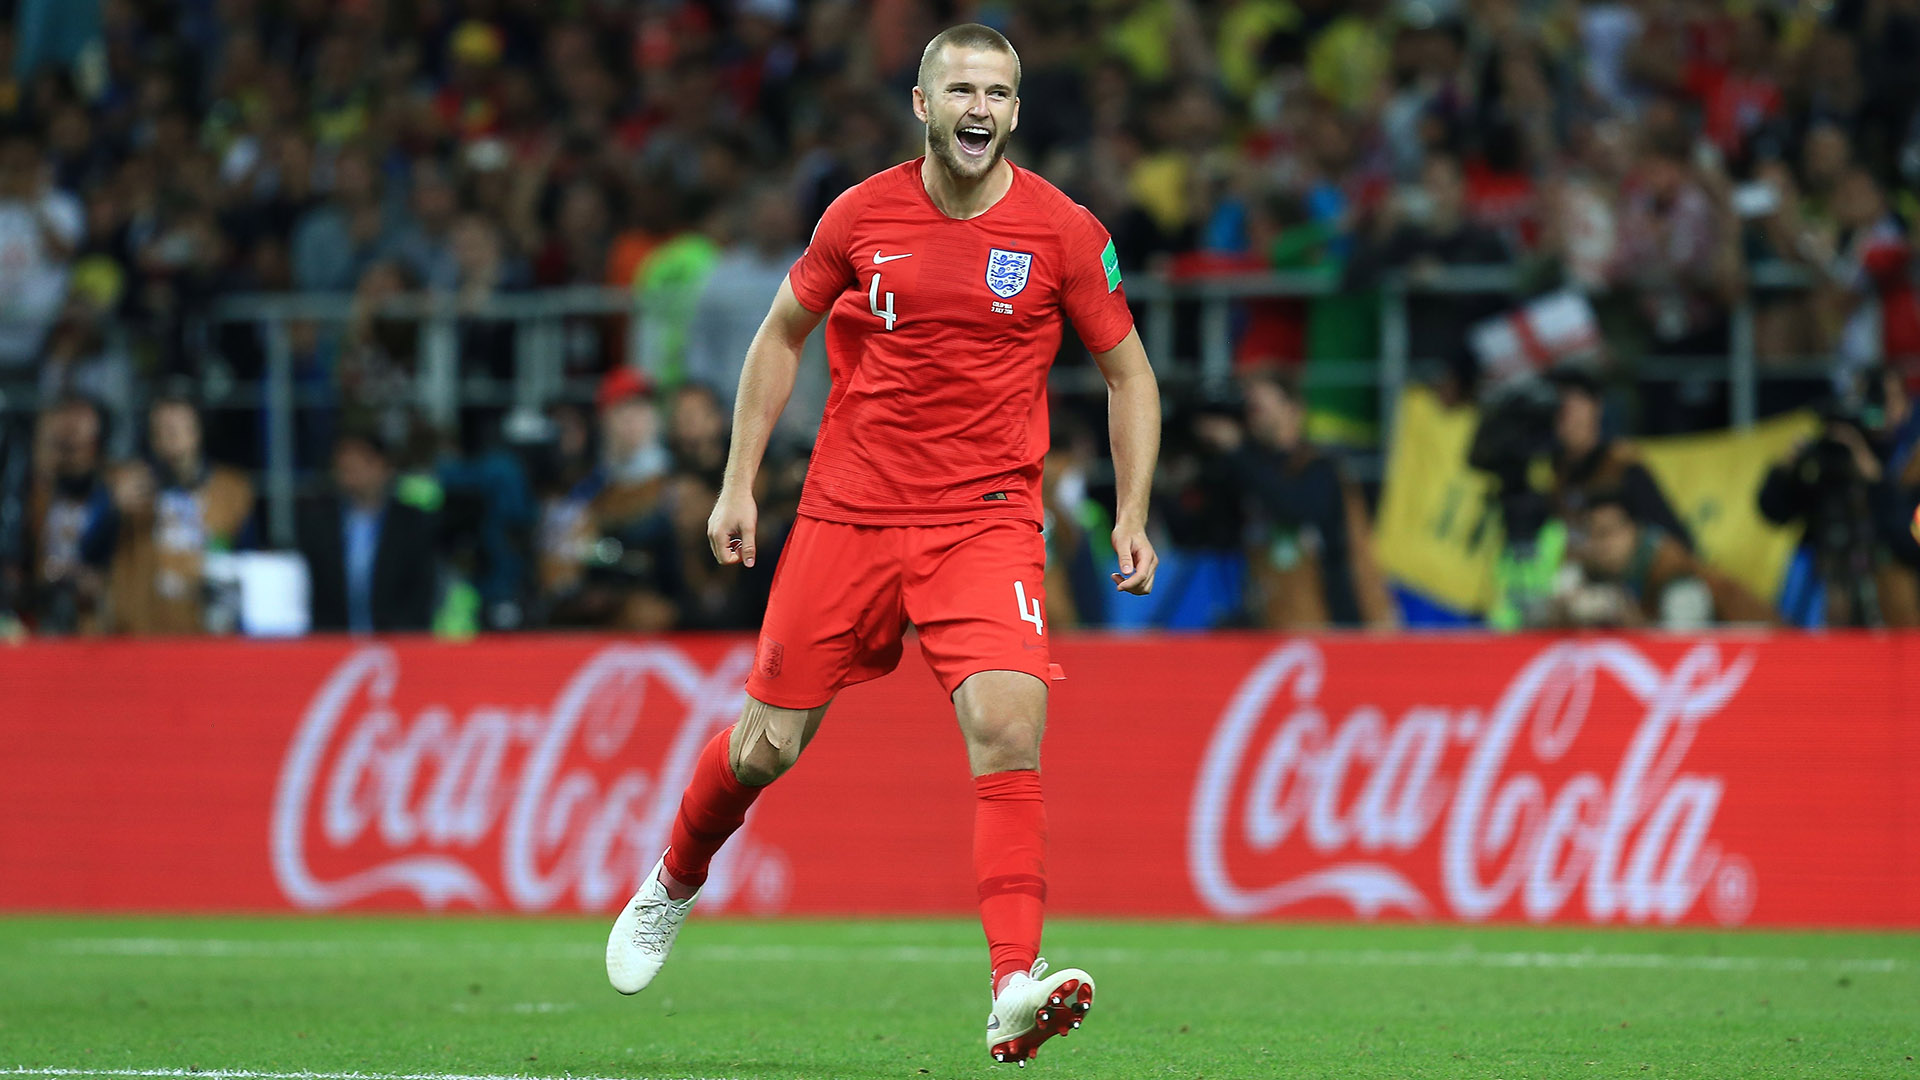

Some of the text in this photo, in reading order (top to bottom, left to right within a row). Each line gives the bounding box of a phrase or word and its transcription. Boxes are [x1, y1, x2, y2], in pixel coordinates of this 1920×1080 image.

[869, 272, 897, 331] 4
[1013, 580, 1044, 636] 4
[270, 642, 764, 912] Coca-Col
[1187, 638, 1757, 923] Coca-Cola
